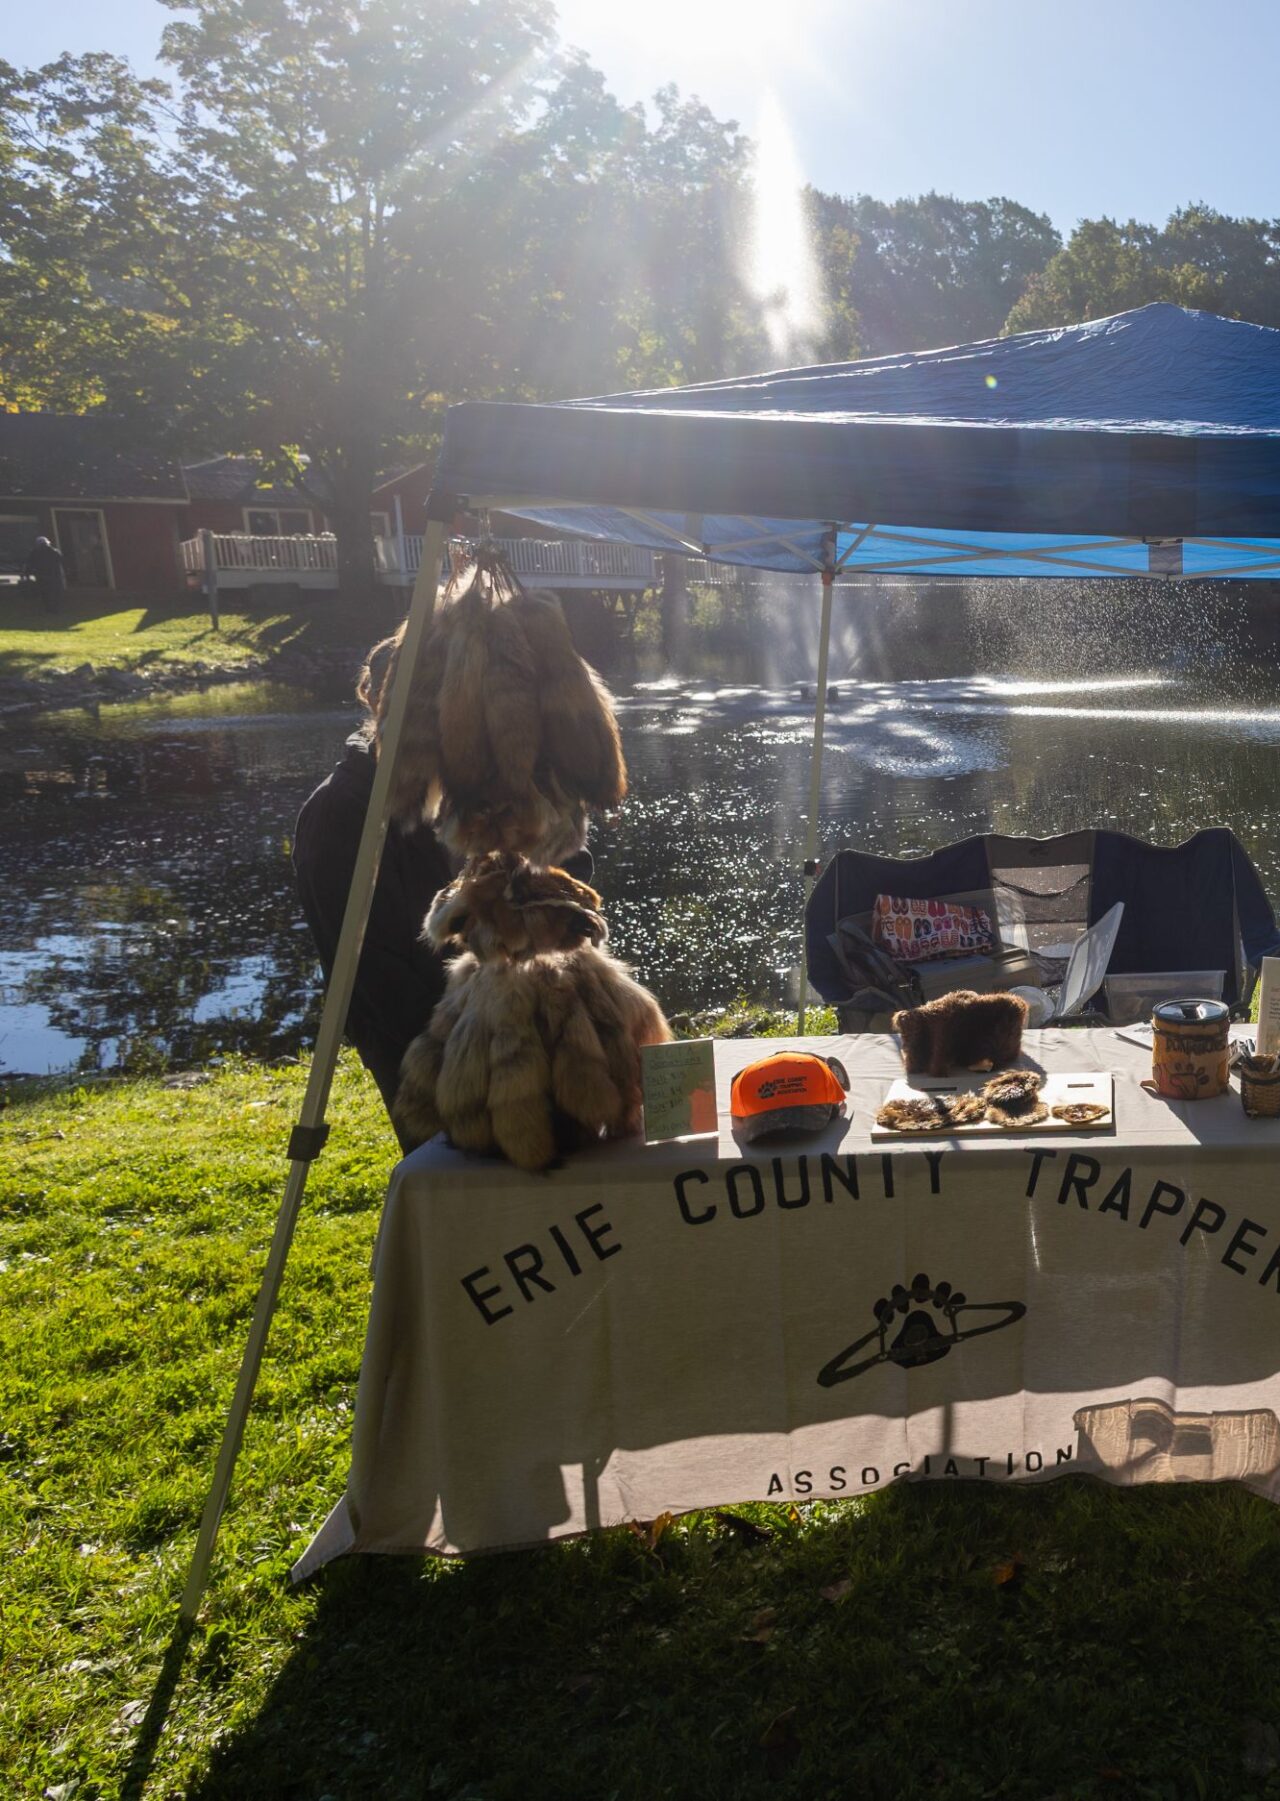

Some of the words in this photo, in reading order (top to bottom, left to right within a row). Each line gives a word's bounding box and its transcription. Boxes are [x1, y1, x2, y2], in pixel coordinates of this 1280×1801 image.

[461, 1203, 622, 1326] ERIE
[674, 1152, 948, 1225] COUNTY
[767, 1444, 1074, 1496] ASSOCIATION
